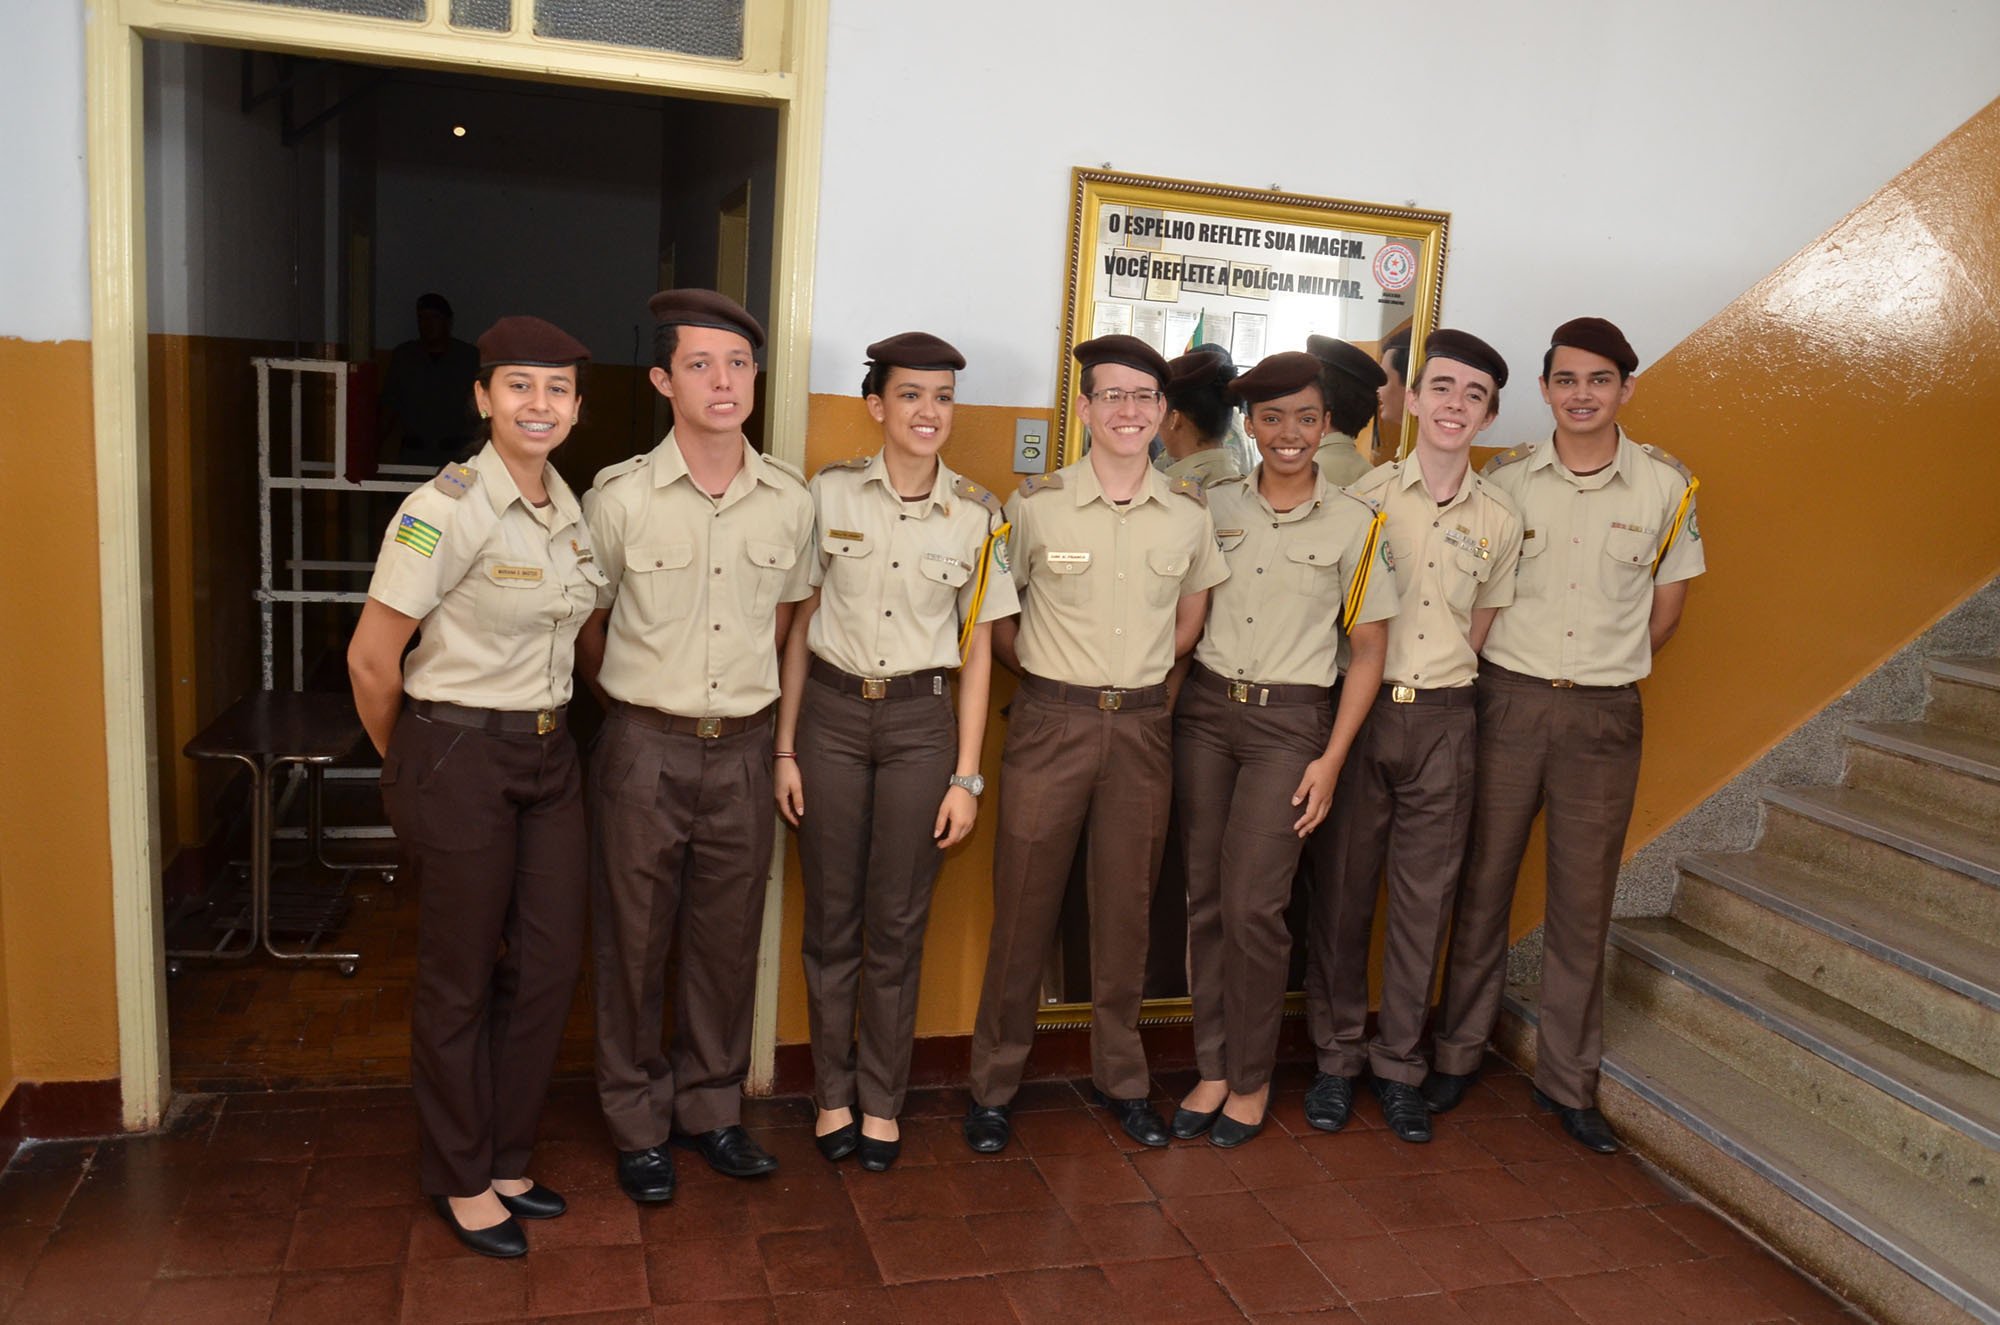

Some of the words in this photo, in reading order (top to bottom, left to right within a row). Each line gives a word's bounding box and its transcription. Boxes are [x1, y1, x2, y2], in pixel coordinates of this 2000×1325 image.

[1109, 213, 1121, 233] O
[1124, 215, 1195, 241] ESPELHO
[1198, 223, 1262, 248] REFLETE
[1264, 230, 1296, 252] SUA
[1299, 234, 1366, 260] IMAGEM.
[1104, 255, 1149, 278] VOCÊ
[1151, 260, 1216, 284] REFLETE
[1217, 266, 1229, 286] A
[1232, 267, 1295, 292] POLÍCIA
[1297, 275, 1364, 300] MILITAR.
